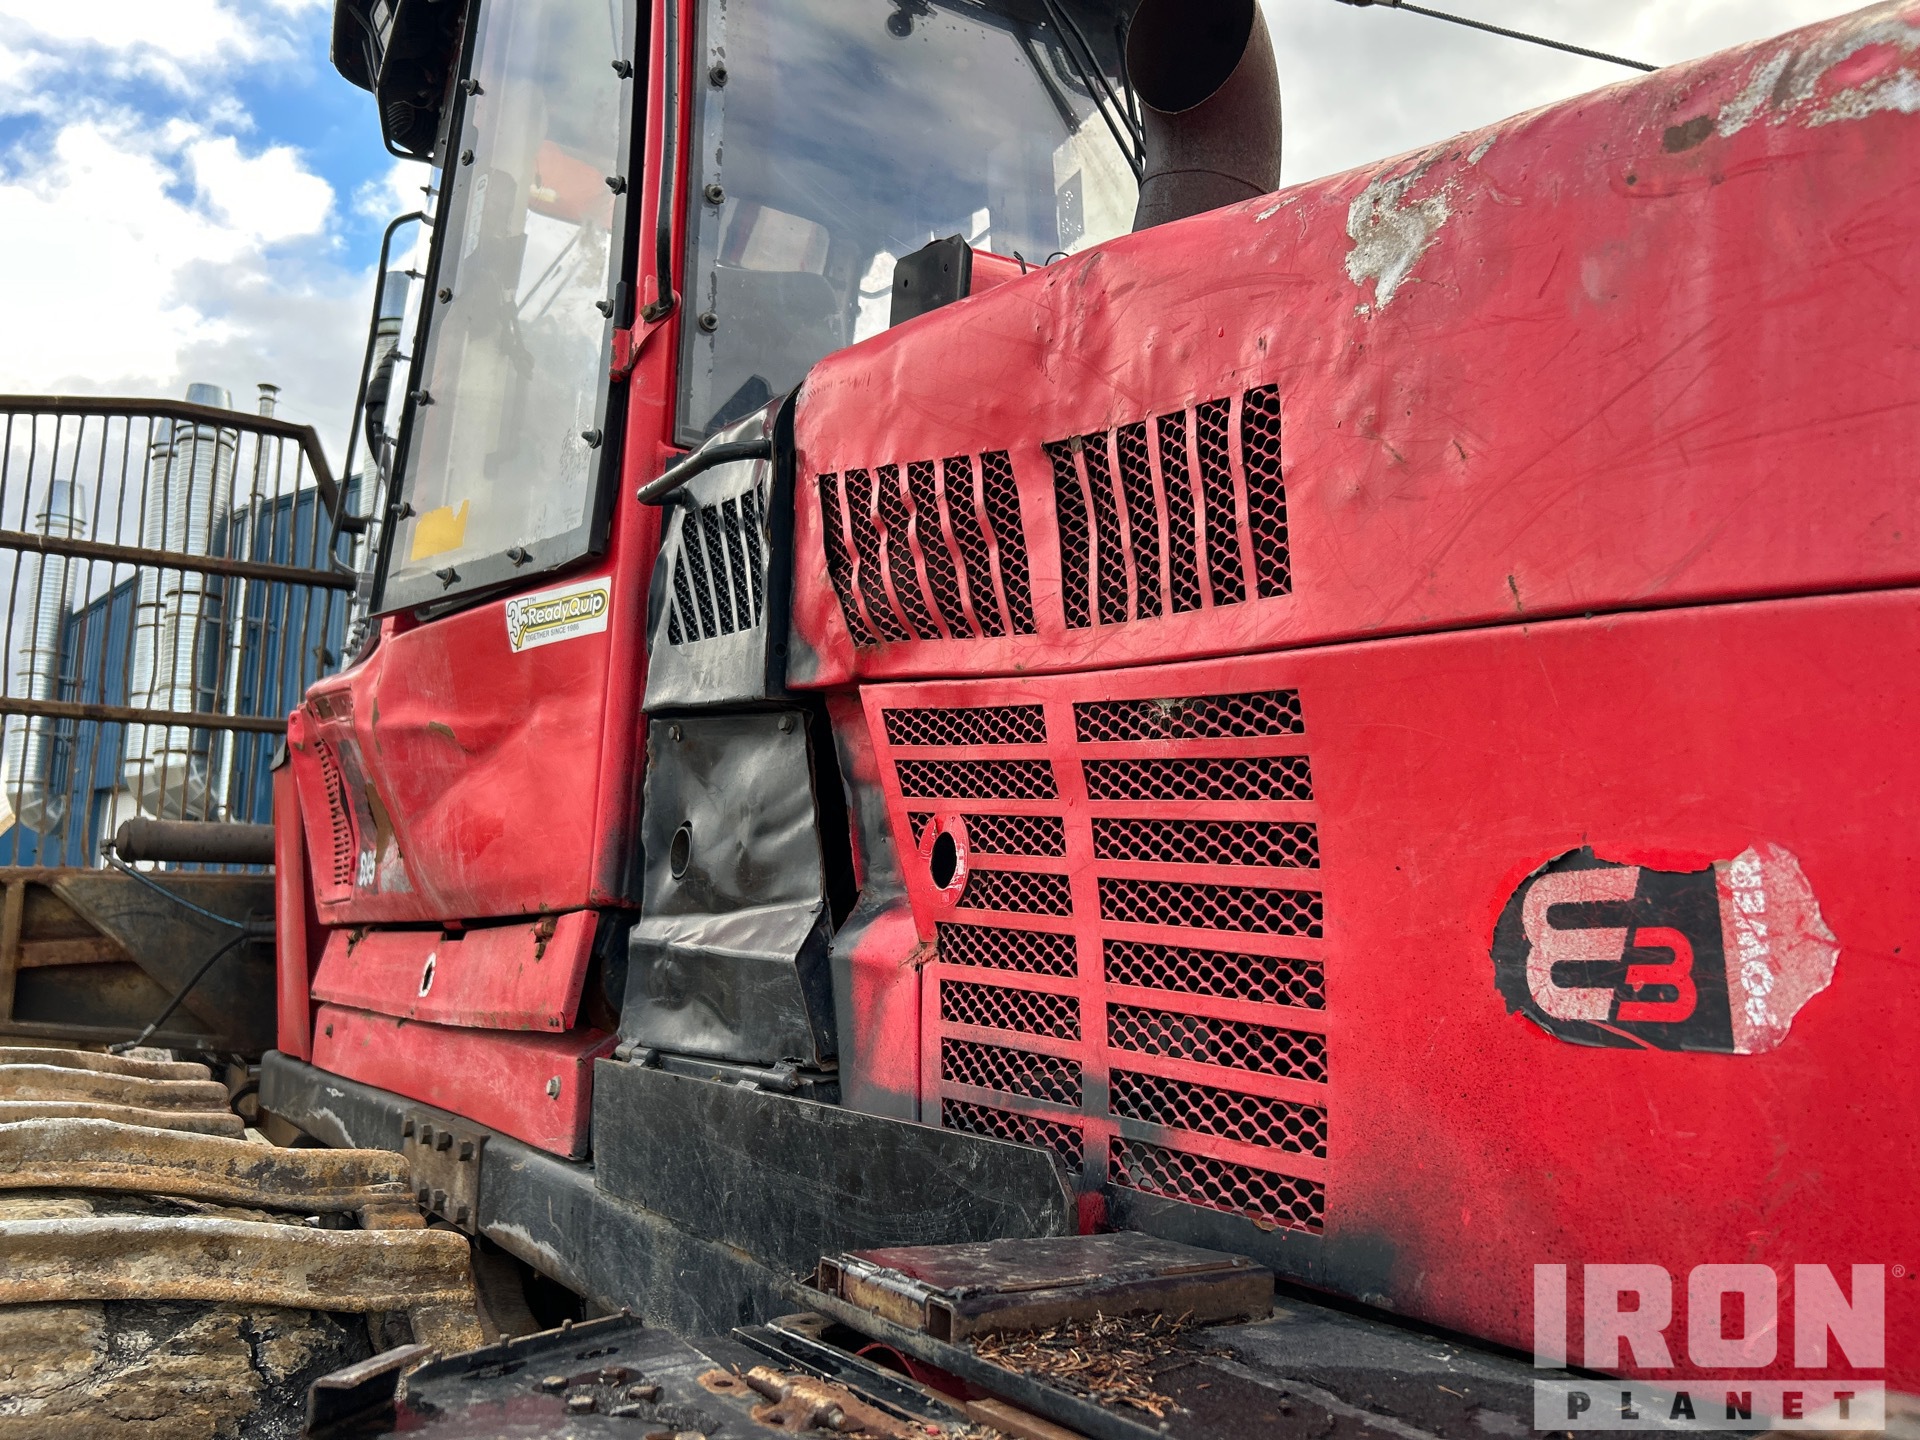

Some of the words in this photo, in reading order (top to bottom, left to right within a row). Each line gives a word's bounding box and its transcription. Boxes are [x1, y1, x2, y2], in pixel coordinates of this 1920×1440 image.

[528, 593, 603, 626] ReadyQuip
[525, 629, 550, 642] TOGETHER
[551, 626, 566, 637] SINCE
